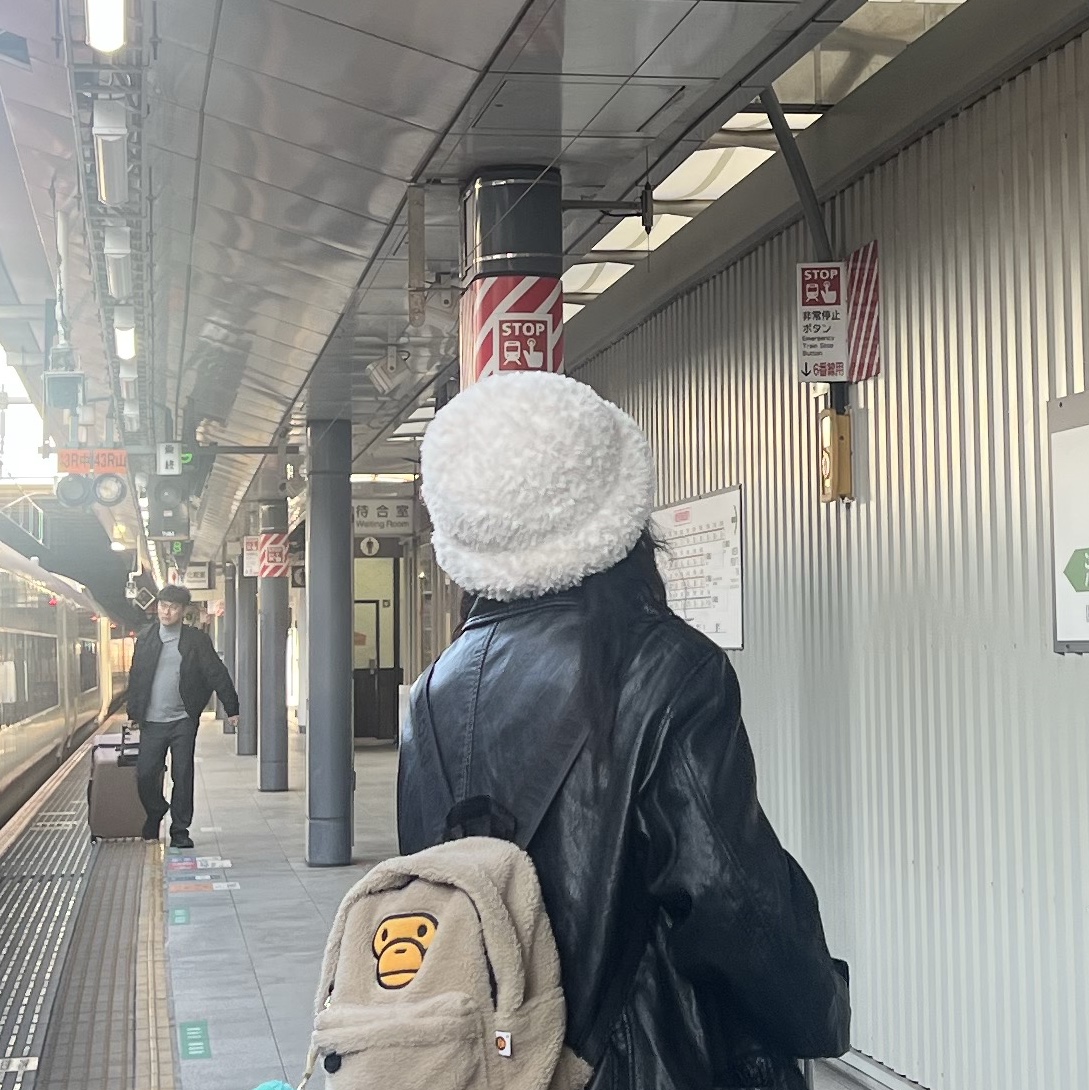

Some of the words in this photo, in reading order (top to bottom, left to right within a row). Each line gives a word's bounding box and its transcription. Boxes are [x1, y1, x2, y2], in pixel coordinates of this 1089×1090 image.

[803, 269, 838, 281] STOP
[803, 310, 841, 321] 非常停止
[502, 322, 545, 336] STOP
[802, 324, 833, 334] ボタン
[356, 504, 409, 518] 待合室
[355, 520, 385, 529] Waiting
[386, 520, 409, 528] Room
